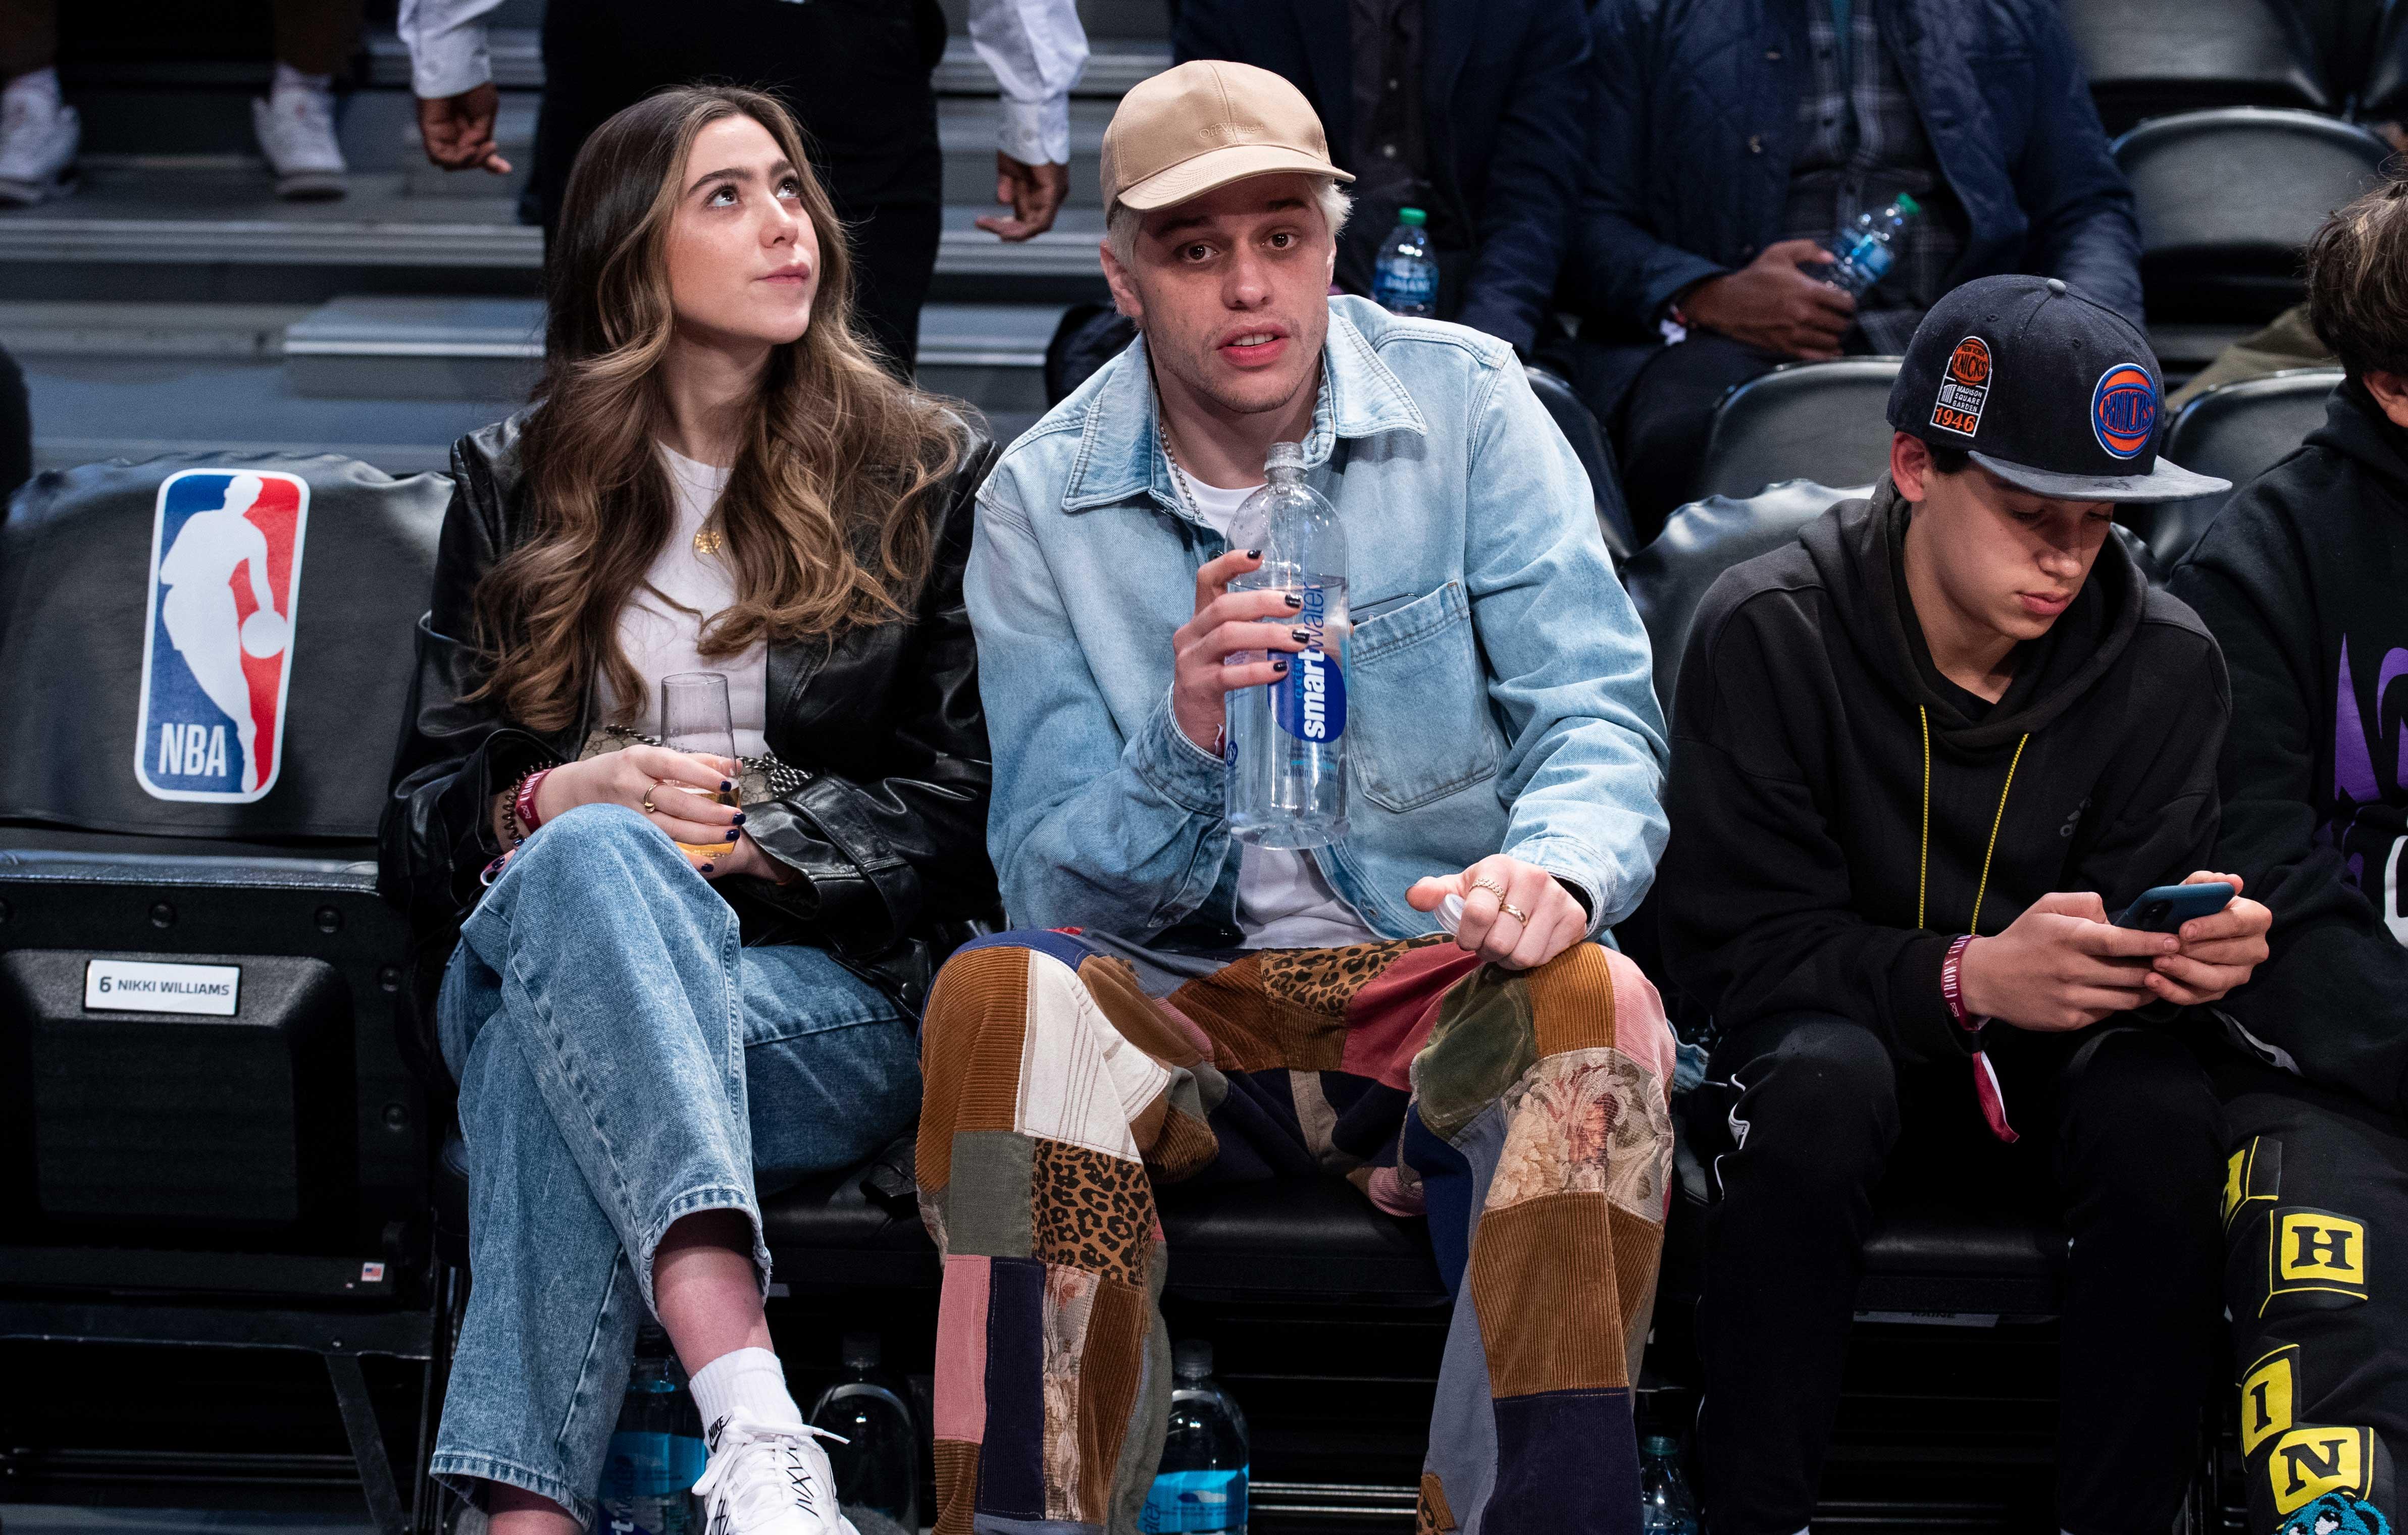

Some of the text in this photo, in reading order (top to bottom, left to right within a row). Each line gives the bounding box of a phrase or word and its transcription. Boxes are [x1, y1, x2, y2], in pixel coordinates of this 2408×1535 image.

[1954, 354, 1987, 378] KNICKS
[1955, 392, 1981, 405] SQUARE
[1957, 385, 1982, 398] MADISON
[1935, 407, 1976, 432] 1946
[1952, 400, 1978, 413] GARDEN
[2103, 391, 2151, 432] KNICKS
[159, 722, 227, 777] NBA
[99, 976, 230, 996] 6 NIKKI WILLIAMS
[1943, 958, 1959, 998] CROWN
[2291, 1226, 2355, 1271] H
[2249, 1381, 2272, 1434] I
[708, 1415, 724, 1443] NIKE
[2279, 1439, 2348, 1497] N
